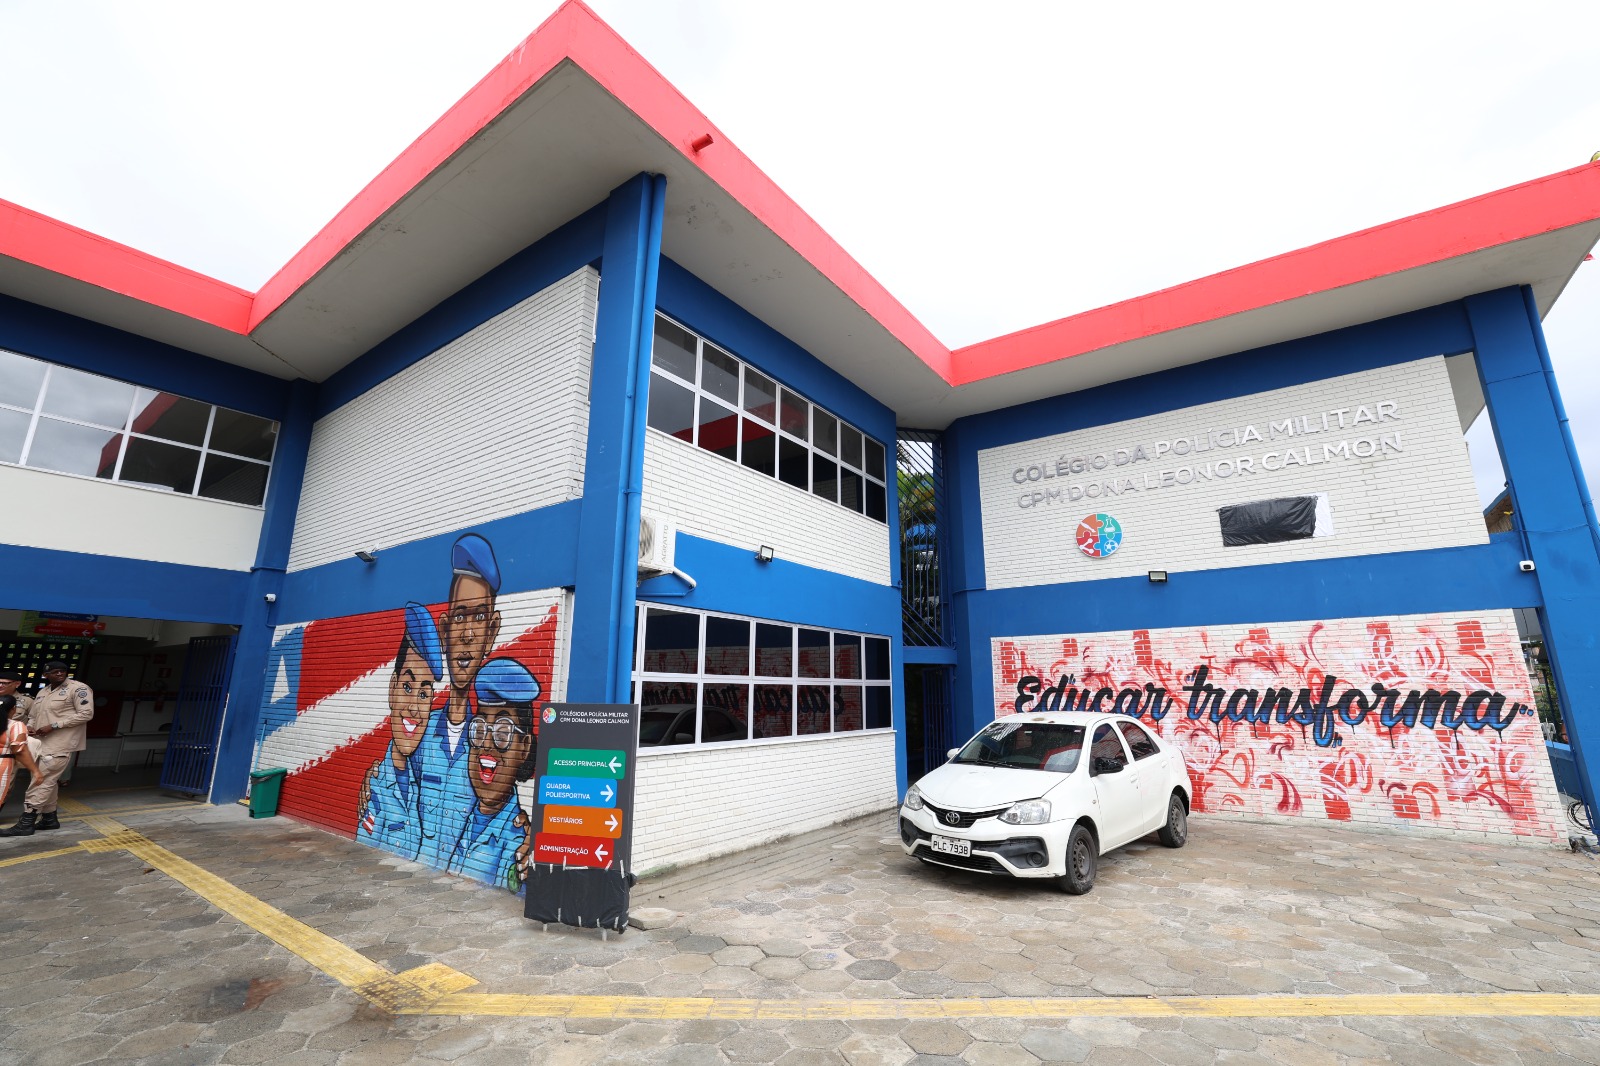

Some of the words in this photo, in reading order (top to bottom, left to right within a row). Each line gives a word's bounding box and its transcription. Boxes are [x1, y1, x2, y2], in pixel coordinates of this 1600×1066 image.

[1012, 454, 1108, 484] COLÉGIO
[1114, 445, 1150, 467] DA
[1154, 424, 1264, 459] POLÍCIA
[1268, 400, 1401, 441] MILITAR
[1017, 488, 1064, 509] CPM
[1069, 477, 1139, 501] DONA
[1143, 455, 1256, 491] LEONOR
[1261, 432, 1403, 471] CALMON
[1015, 674, 1174, 721] Educar
[1183, 665, 1520, 748] transforma
[553, 759, 577, 767] ACESSO
[577, 760, 609, 768] PRINCIPAL
[546, 782, 571, 790] QUADRA
[545, 791, 591, 800] POLIESPORTIVA
[548, 816, 583, 825] VESTIÁRIOS
[539, 844, 589, 856] ADMINISTRAÇÃO
[932, 840, 947, 852] PLC
